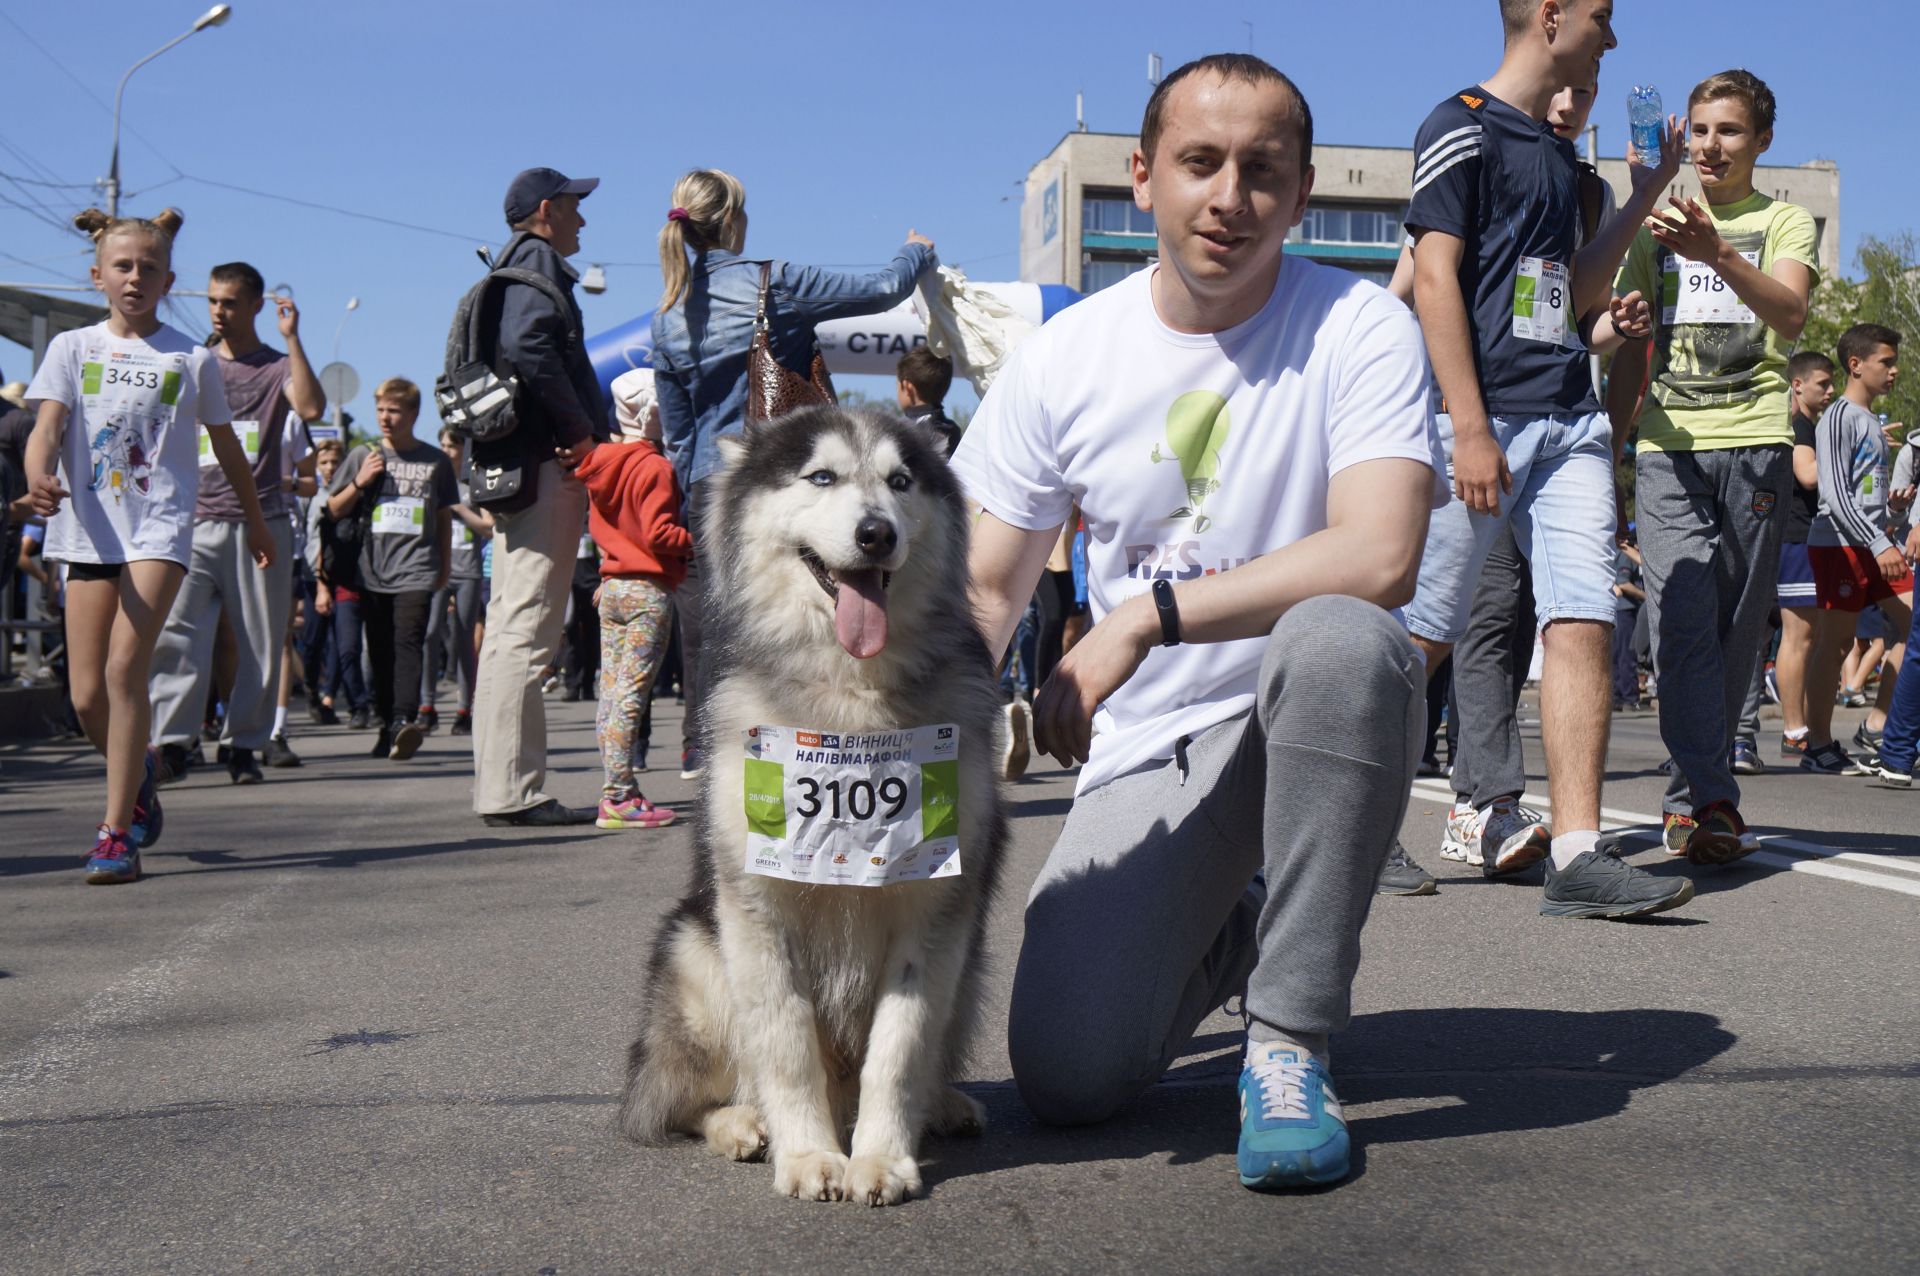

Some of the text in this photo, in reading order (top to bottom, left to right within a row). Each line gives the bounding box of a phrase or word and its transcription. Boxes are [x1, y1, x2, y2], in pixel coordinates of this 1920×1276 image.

[1689, 274, 1724, 292] 918
[1550, 287, 1561, 309] 8
[106, 368, 158, 389] 3453
[384, 507, 410, 518] 3752
[800, 735, 818, 744] auto
[845, 733, 914, 749] ВІННИЦЯ
[796, 749, 912, 765] НАПІВМАРАФОН
[796, 777, 908, 820] 3109
